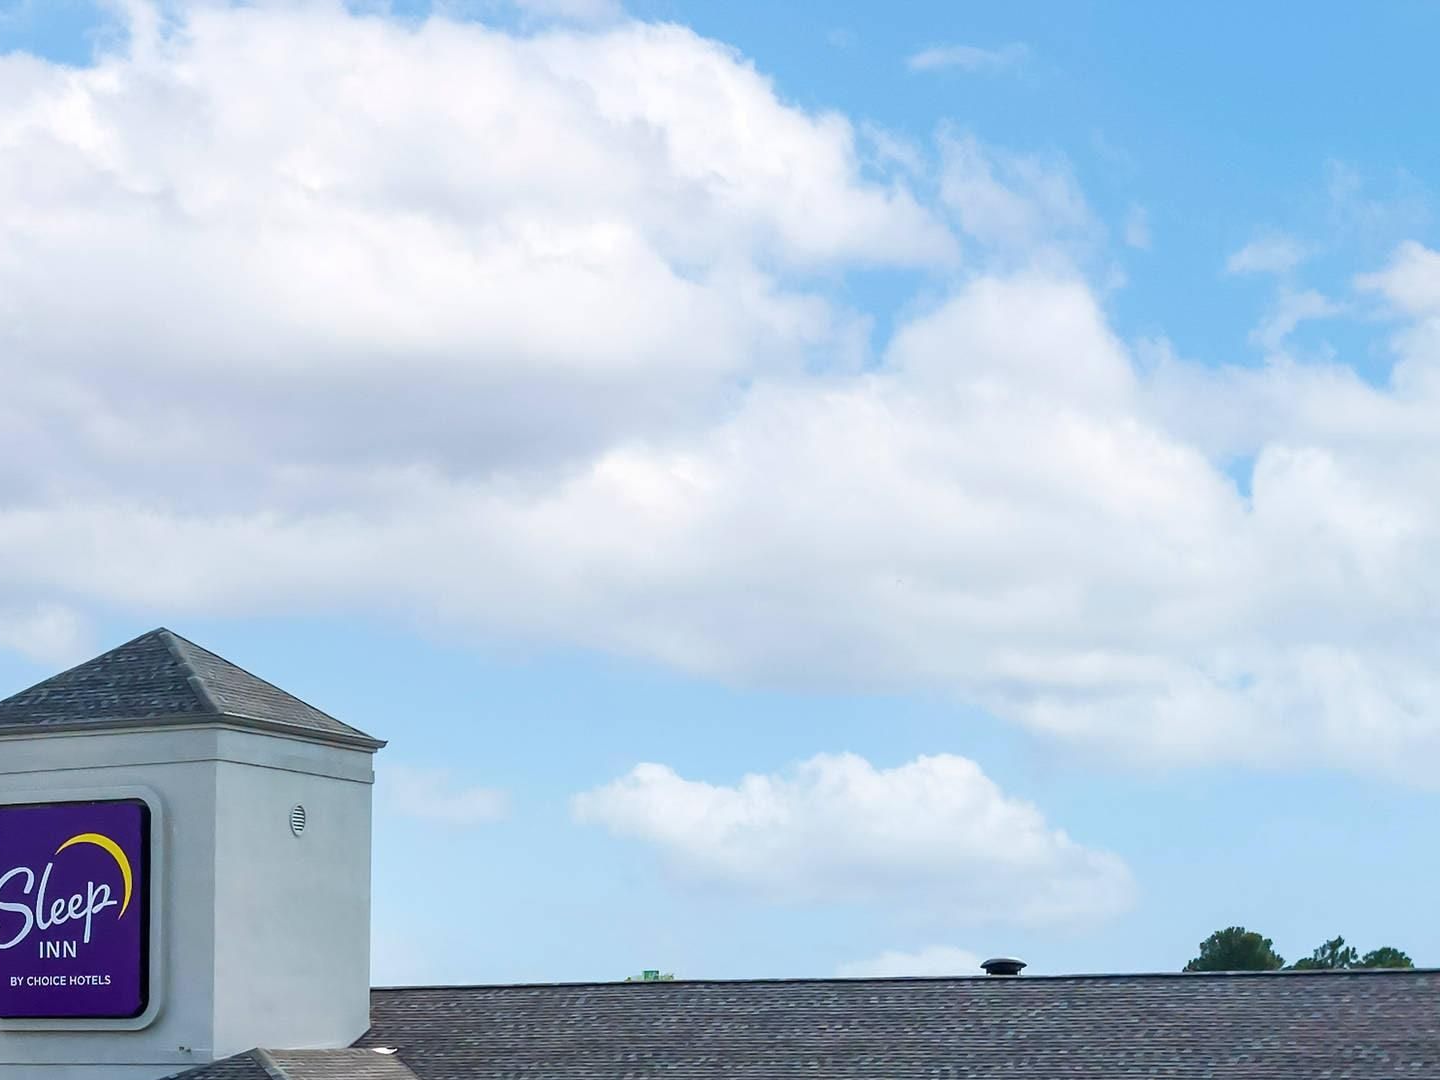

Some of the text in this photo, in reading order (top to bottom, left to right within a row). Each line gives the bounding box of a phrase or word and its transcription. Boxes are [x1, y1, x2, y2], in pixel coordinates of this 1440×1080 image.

[39, 940, 78, 959] INN
[10, 974, 112, 987] BY CHOICE HOTELS
